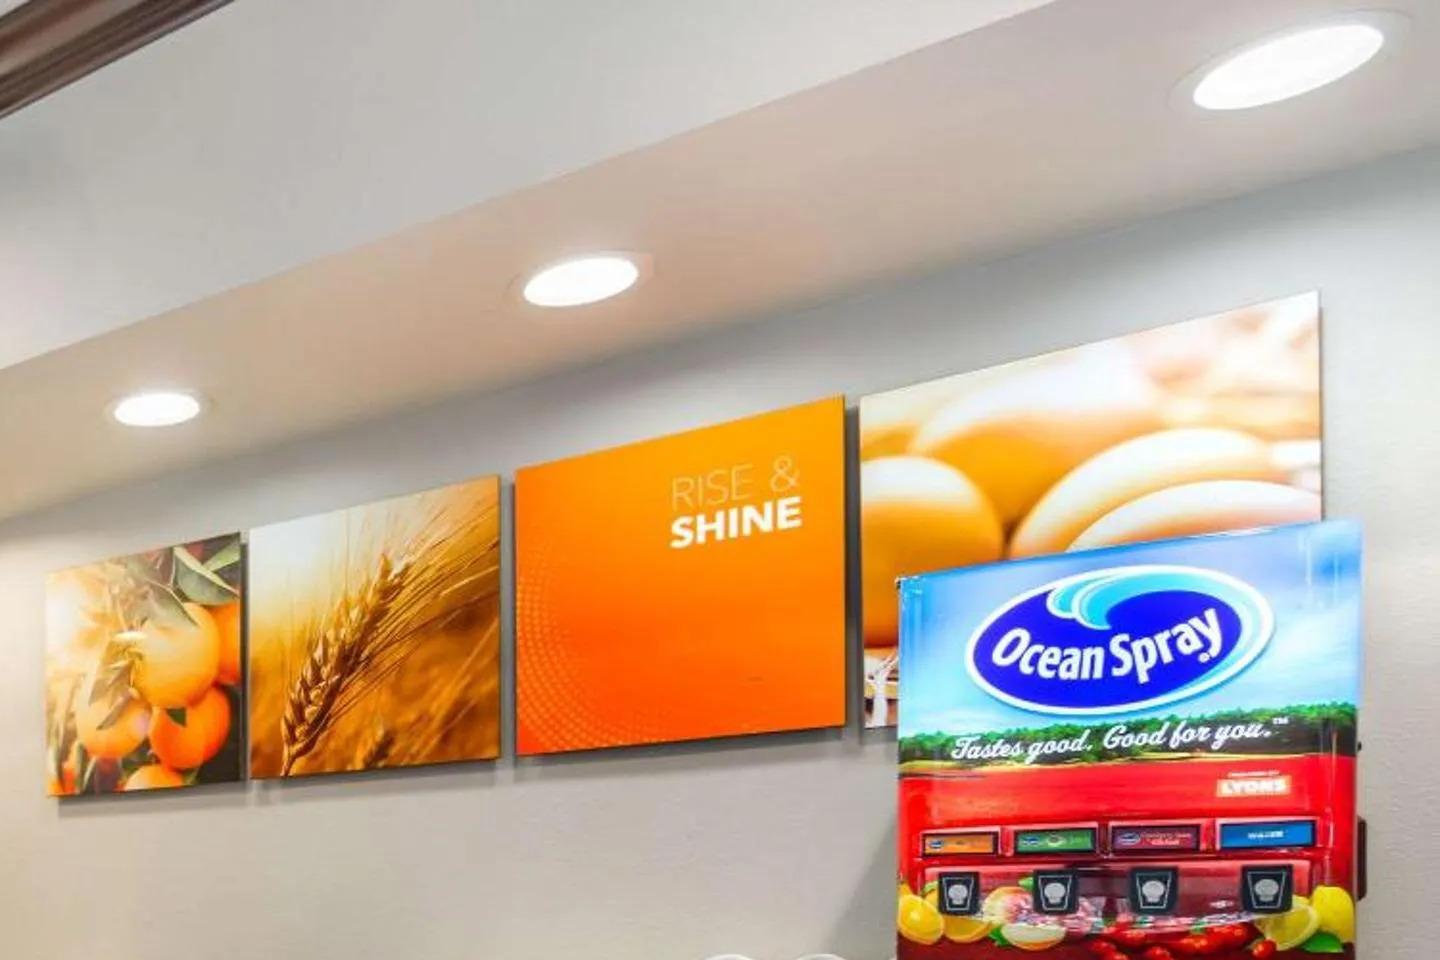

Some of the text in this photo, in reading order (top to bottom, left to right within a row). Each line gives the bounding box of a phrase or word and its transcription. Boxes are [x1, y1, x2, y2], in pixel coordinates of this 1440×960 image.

[671, 454, 800, 511] RISE &
[670, 495, 802, 549] SHINE
[991, 608, 1222, 684] Ocean Spray
[951, 736, 1021, 760] Tastes
[1024, 728, 1093, 765] good.
[1103, 721, 1170, 749] Good
[1169, 720, 1210, 749] for
